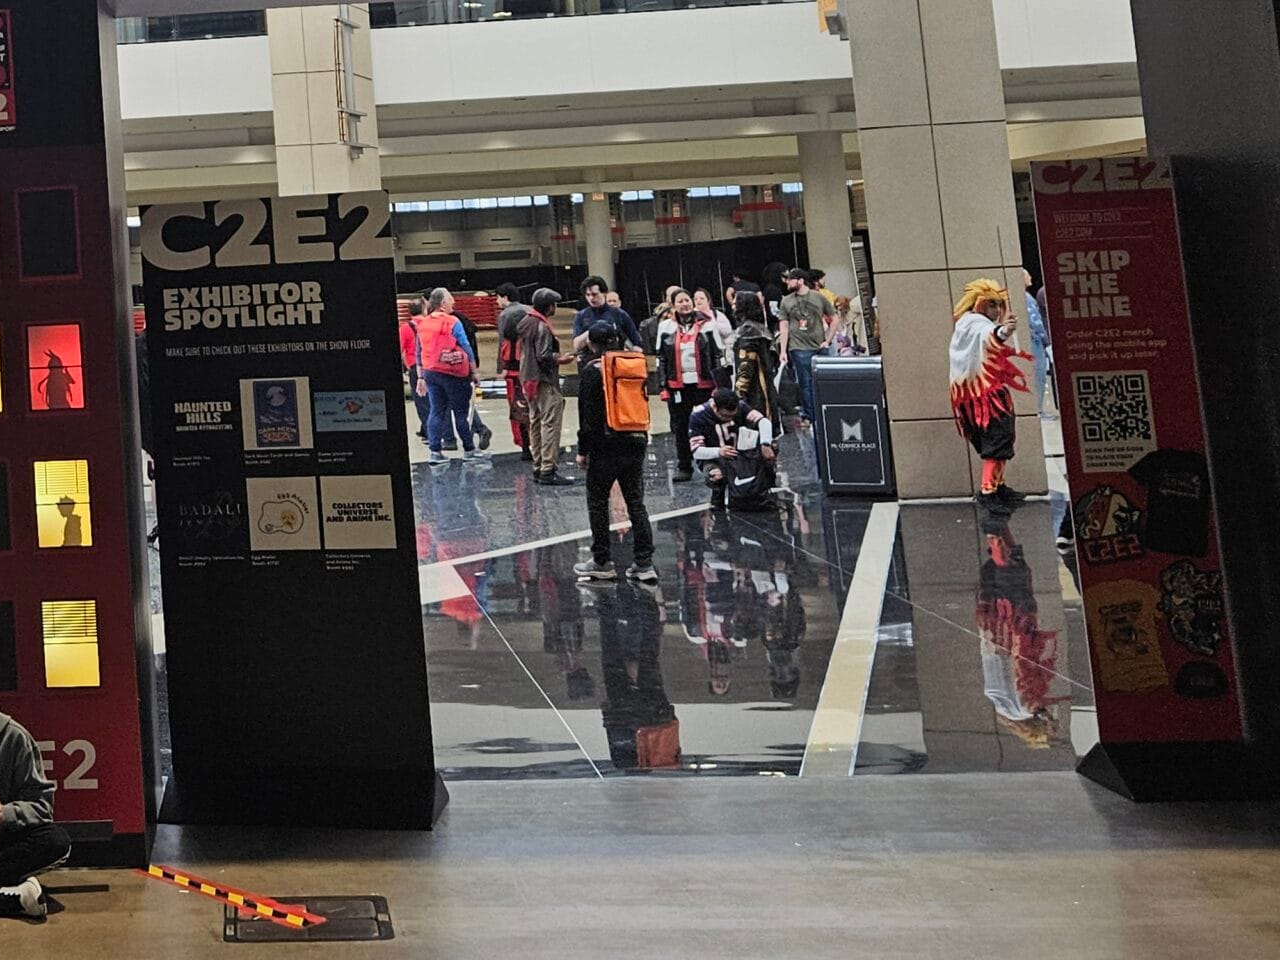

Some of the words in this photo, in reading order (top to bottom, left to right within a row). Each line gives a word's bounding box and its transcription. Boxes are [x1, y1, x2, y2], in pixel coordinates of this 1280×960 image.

[1031, 157, 1174, 195] C2E2
[139, 189, 396, 271] C2E2
[1057, 250, 1130, 273] SKIP
[1059, 273, 1120, 295] THE
[163, 281, 322, 309] EXHIBITOR
[1062, 296, 1132, 318] LINE
[164, 303, 324, 331] SPOTLIGHT
[1066, 330, 1093, 339] Order
[1095, 329, 1120, 337] C2E2
[1122, 328, 1154, 337] merch
[165, 347, 183, 357] MAKE
[185, 347, 200, 357] SURE
[202, 347, 211, 356] TO
[212, 346, 231, 356] CHECK
[233, 345, 246, 355] OUT
[248, 344, 266, 354] THESE
[267, 343, 304, 353] EXHIBITORS
[305, 342, 315, 352] ON
[316, 342, 327, 351] THE
[329, 340, 348, 350] SHOW
[1067, 342, 1093, 350] using
[1148, 340, 1168, 348] app
[1069, 352, 1087, 360] and
[1089, 352, 1108, 360] pick
[174, 401, 232, 414] HAUNTED
[186, 411, 221, 423] HILLS
[179, 503, 241, 516] BADALI
